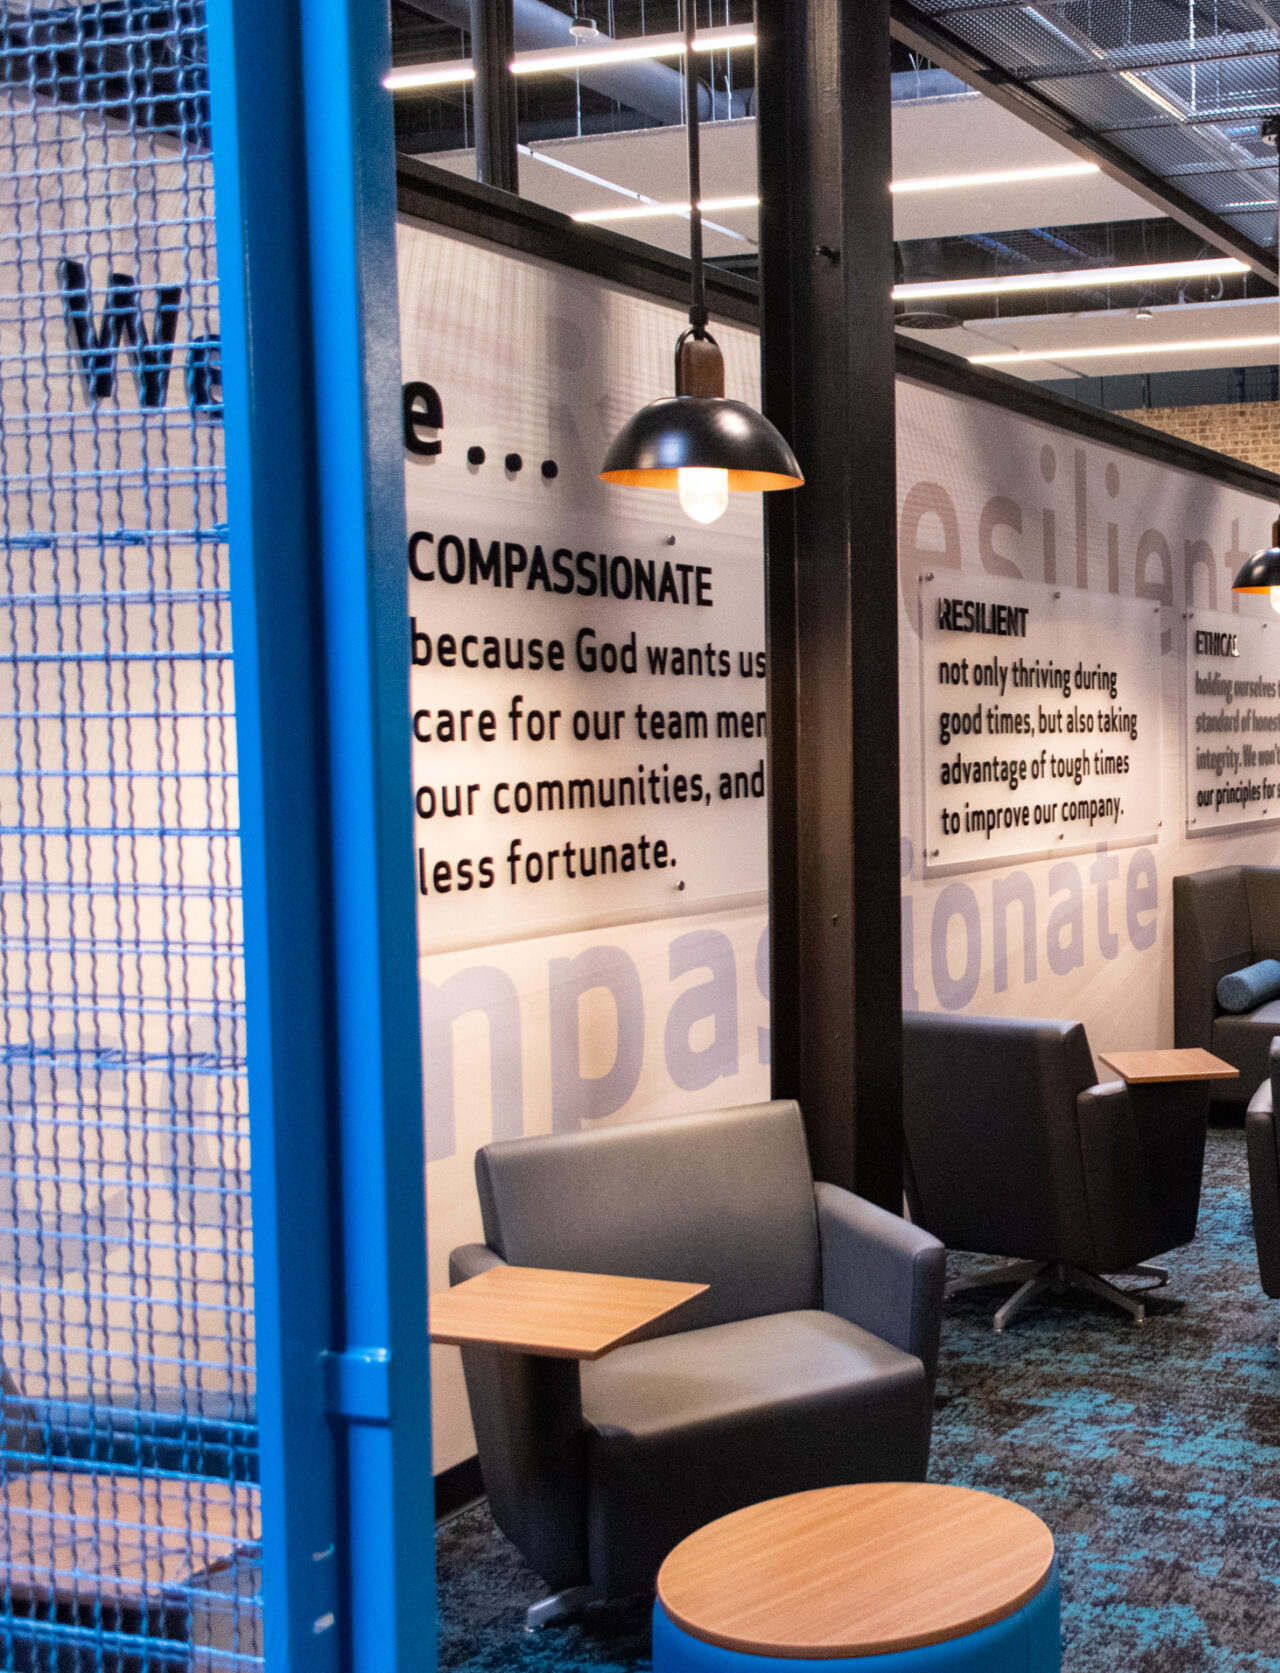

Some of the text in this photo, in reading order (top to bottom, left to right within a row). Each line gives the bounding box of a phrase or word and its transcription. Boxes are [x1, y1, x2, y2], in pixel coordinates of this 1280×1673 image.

[408, 530, 714, 608] COMPASSIONATE
[938, 597, 1029, 638] RESILIENT
[410, 616, 767, 678] because God wants us
[1196, 630, 1240, 658] ETHICAL
[938, 656, 1118, 700] not only thriving during
[1195, 671, 1232, 704] holding
[1234, 675, 1276, 700] ourselves
[413, 709, 497, 742] care
[508, 695, 561, 741] for
[573, 709, 625, 741] our
[635, 703, 708, 740] team
[939, 704, 1138, 746] good times, but also taking
[1195, 709, 1240, 733] standard
[1241, 709, 1252, 732] of
[940, 749, 1130, 790] advantage of tough times
[1196, 745, 1242, 776] integrity.
[1242, 743, 1257, 768] We
[1258, 743, 1280, 766] won't
[415, 760, 765, 820] our communities, and
[1197, 788, 1214, 807] our
[1216, 779, 1261, 811] principles
[1263, 777, 1275, 799] for
[942, 795, 1124, 839] to improve our company.
[418, 835, 678, 895] less fortunate.
